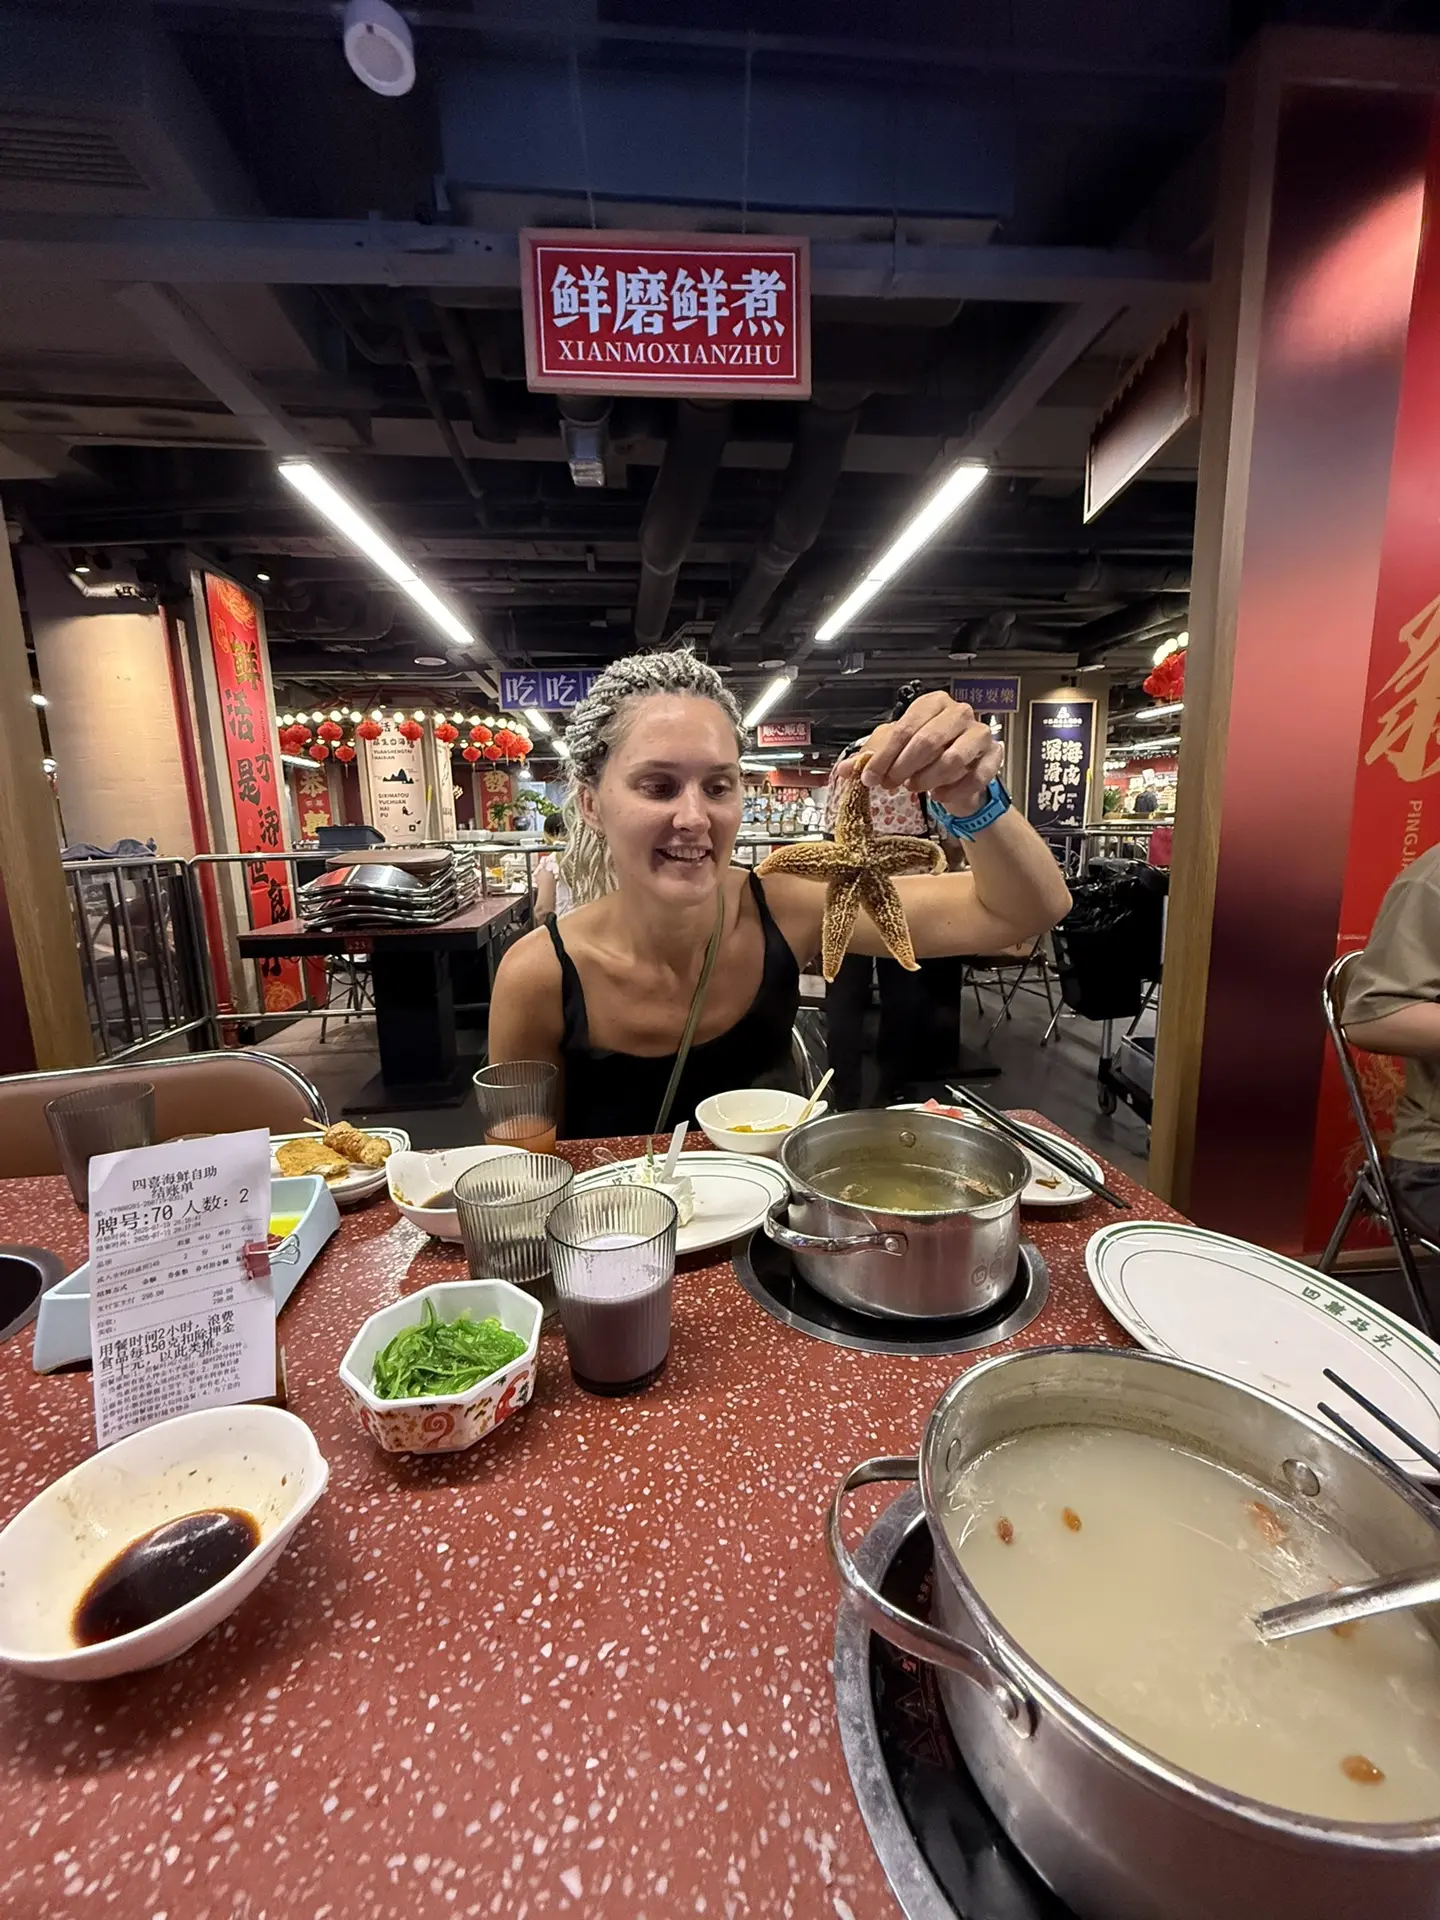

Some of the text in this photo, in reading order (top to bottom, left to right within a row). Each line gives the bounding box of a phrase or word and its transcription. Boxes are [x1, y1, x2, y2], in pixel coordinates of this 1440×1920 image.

[550, 264, 786, 338] 鲜磨鲜煮
[557, 340, 781, 365] XIANMOXIANZHU
[505, 675, 595, 707] 吃吃
[132, 1165, 217, 1192] 四喜海鲜自助
[151, 1180, 195, 1200] 结账单
[95, 1204, 174, 1238] 牌号:70
[239, 1187, 249, 1203] 2
